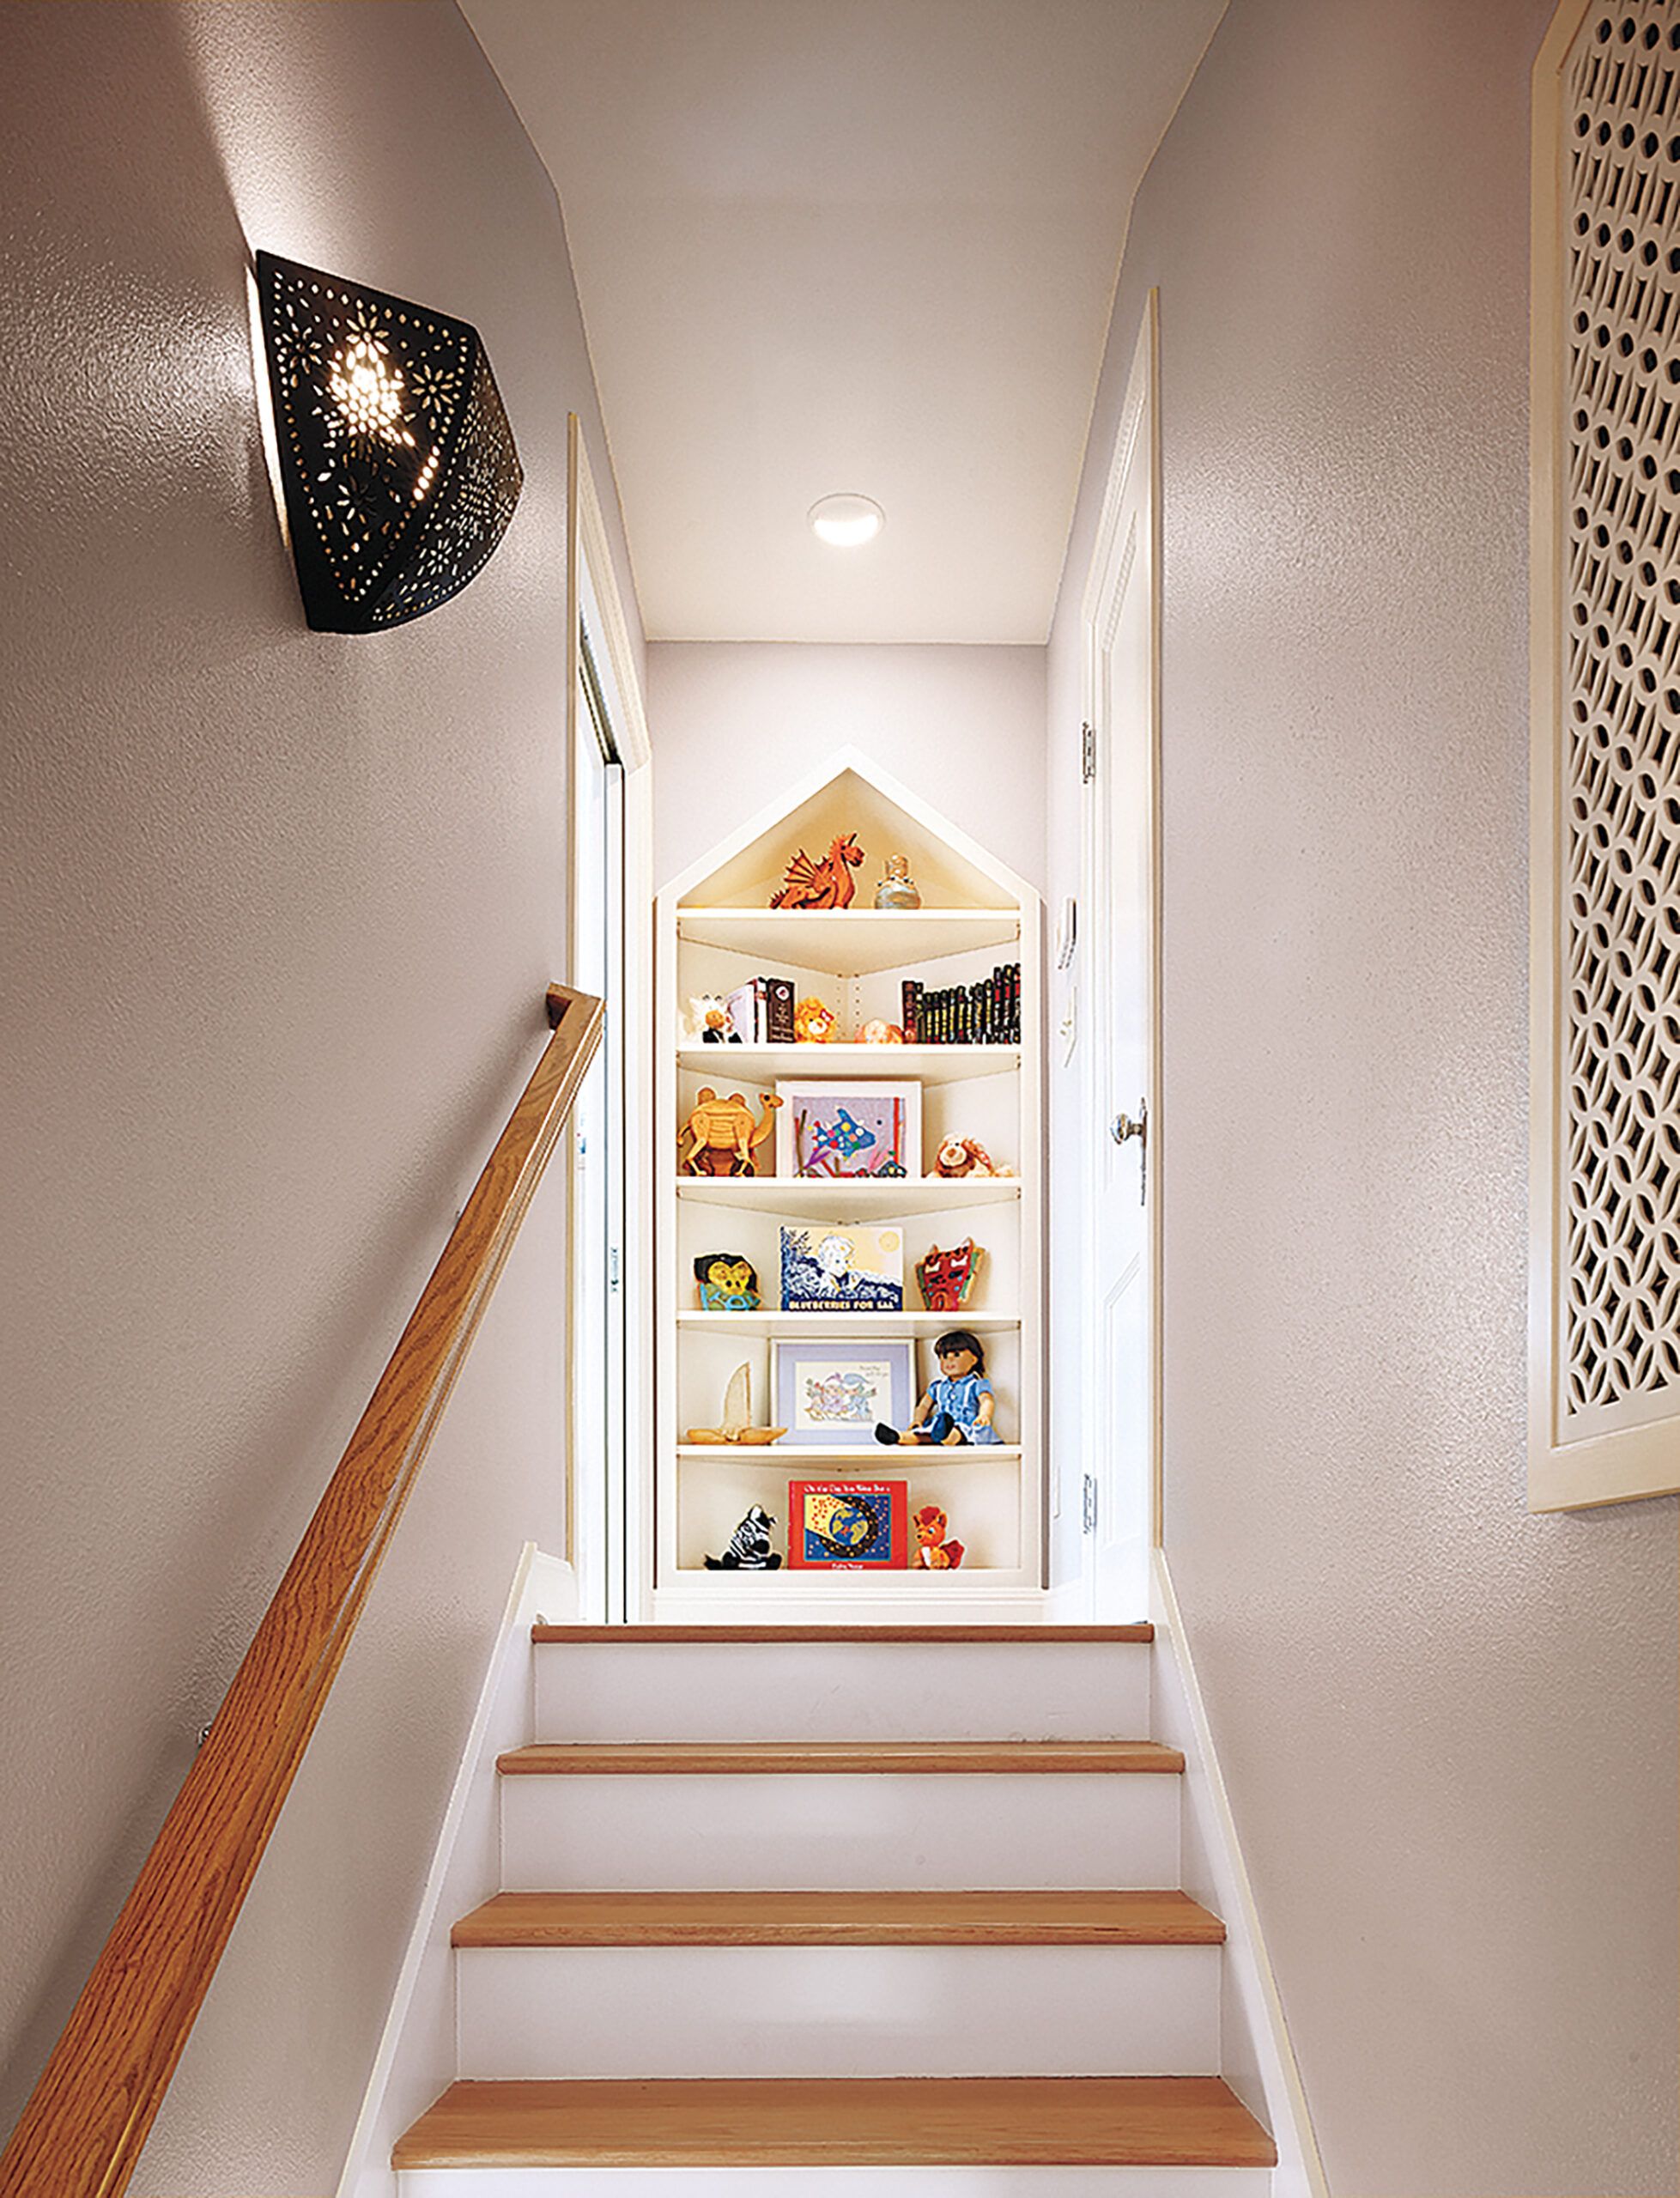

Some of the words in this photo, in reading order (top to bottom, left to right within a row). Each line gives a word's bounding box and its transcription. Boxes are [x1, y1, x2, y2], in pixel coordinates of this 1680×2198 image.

[789, 1301, 850, 1309] BLUEBERRIES
[853, 1301, 873, 1309] FOR
[876, 1301, 895, 1309] SAL
